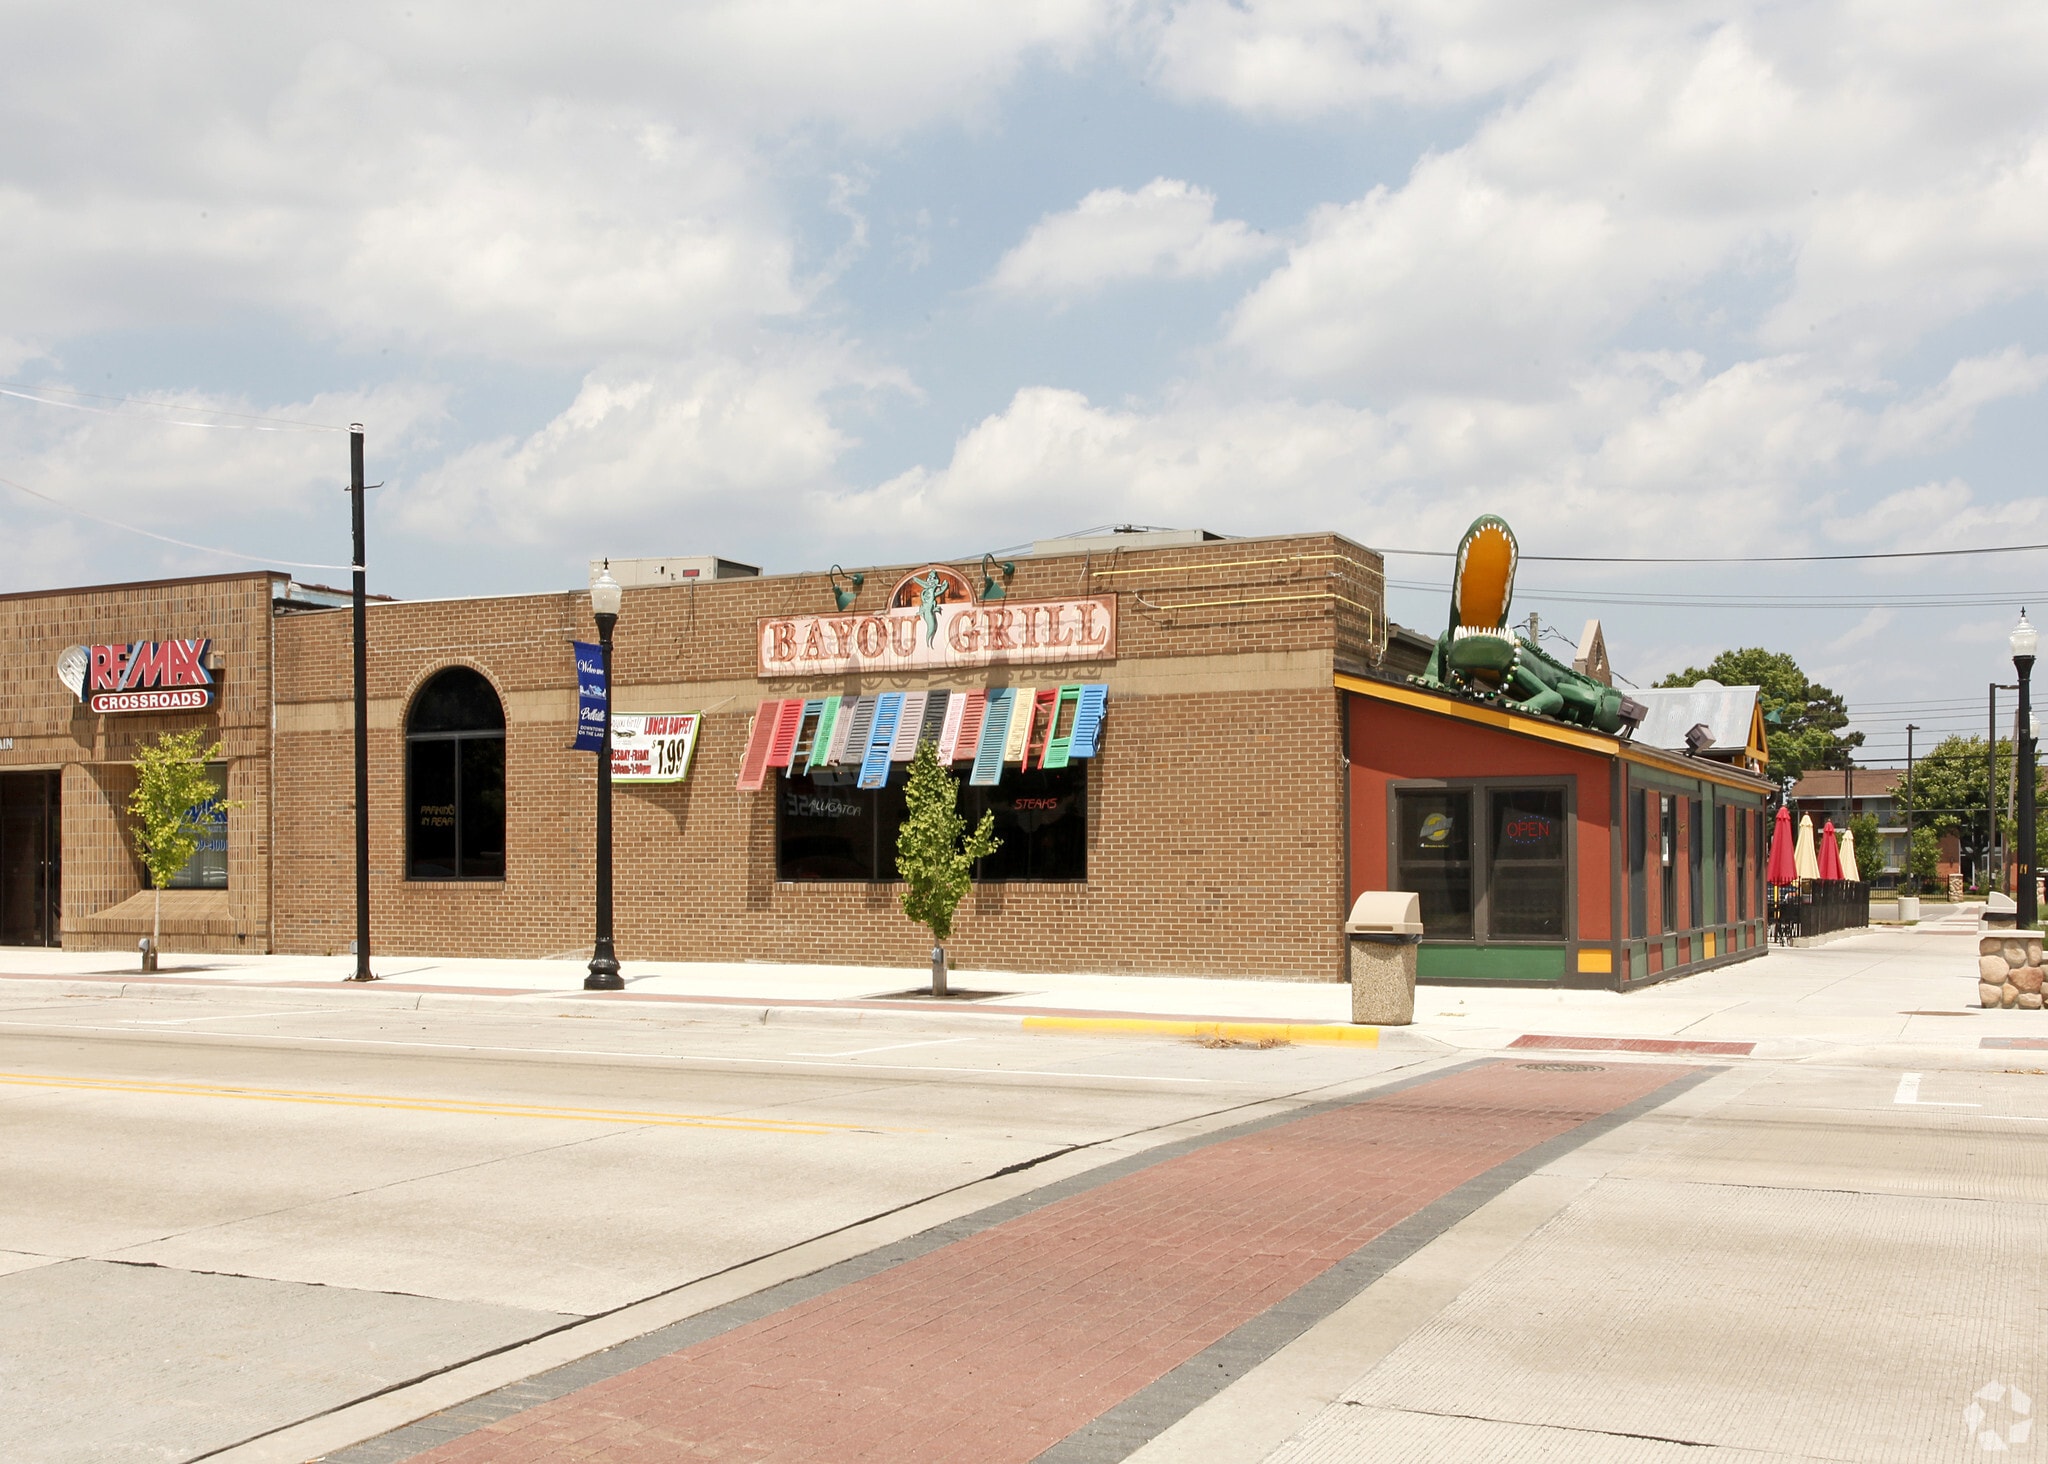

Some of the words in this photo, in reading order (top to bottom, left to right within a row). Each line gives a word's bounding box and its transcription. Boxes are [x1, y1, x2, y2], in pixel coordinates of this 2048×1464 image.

[769, 618, 921, 662] BAYOU
[948, 604, 1107, 653] GRILL
[91, 639, 208, 691] RE/MAX
[98, 692, 201, 710] CROSSROADS
[644, 717, 667, 735] LUNCH
[667, 717, 695, 735] BUFFET
[808, 799, 862, 817] ALLIGATOR
[1014, 797, 1058, 810] STEAKS
[1506, 821, 1550, 837] OPEN
